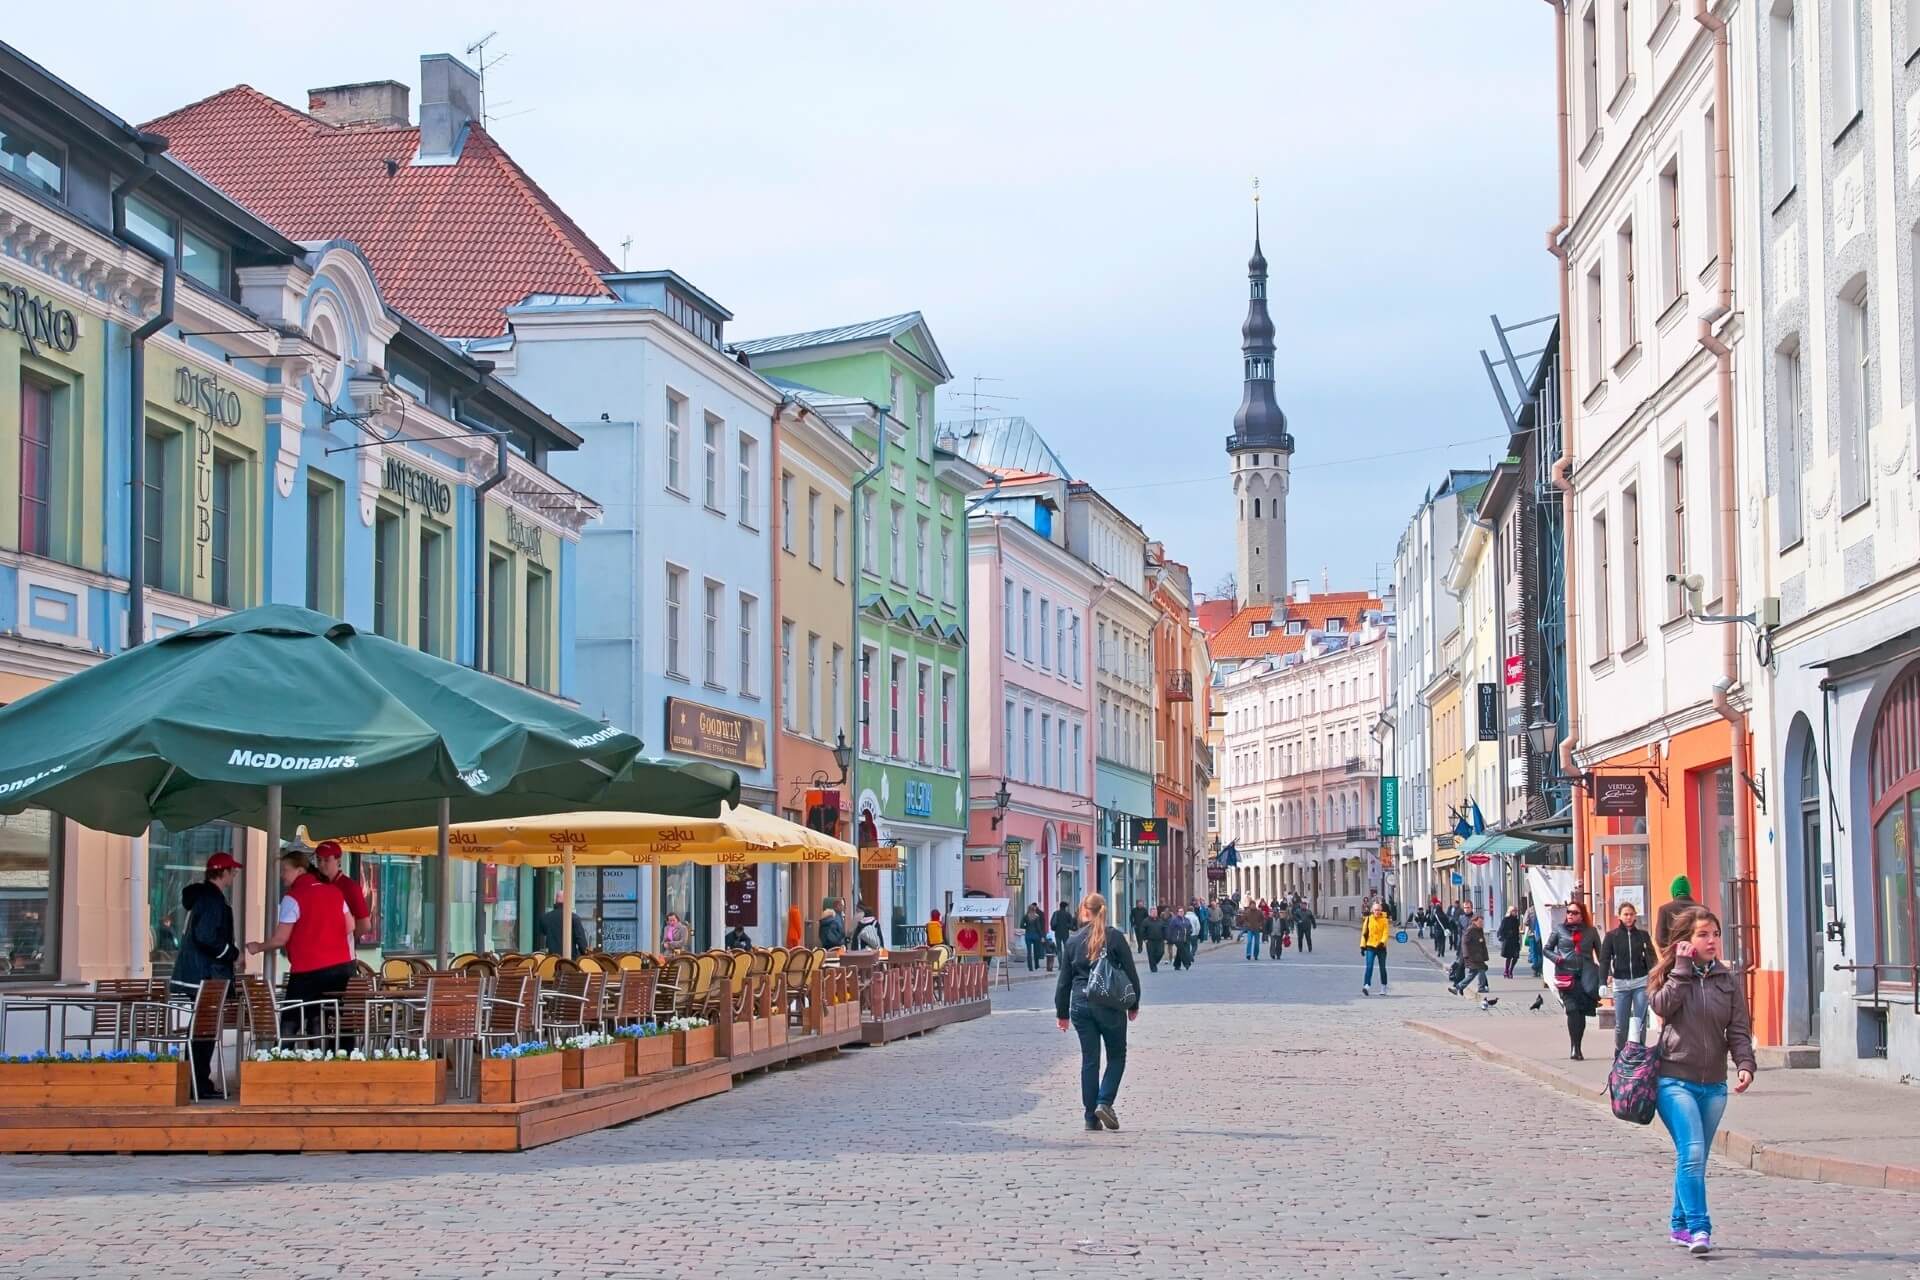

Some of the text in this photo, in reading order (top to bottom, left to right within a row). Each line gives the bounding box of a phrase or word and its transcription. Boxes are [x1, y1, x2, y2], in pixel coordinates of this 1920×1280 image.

[175, 366, 242, 431] DISKO
[197, 424, 211, 579] PUBI
[386, 456, 452, 519] INFERNO
[699, 711, 742, 742] GOODWIN
[228, 748, 356, 770] McDonald's
[1386, 781, 1394, 831] SALAMANDER
[449, 830, 477, 844] aku
[549, 829, 586, 843] saku
[657, 826, 695, 842] saku
